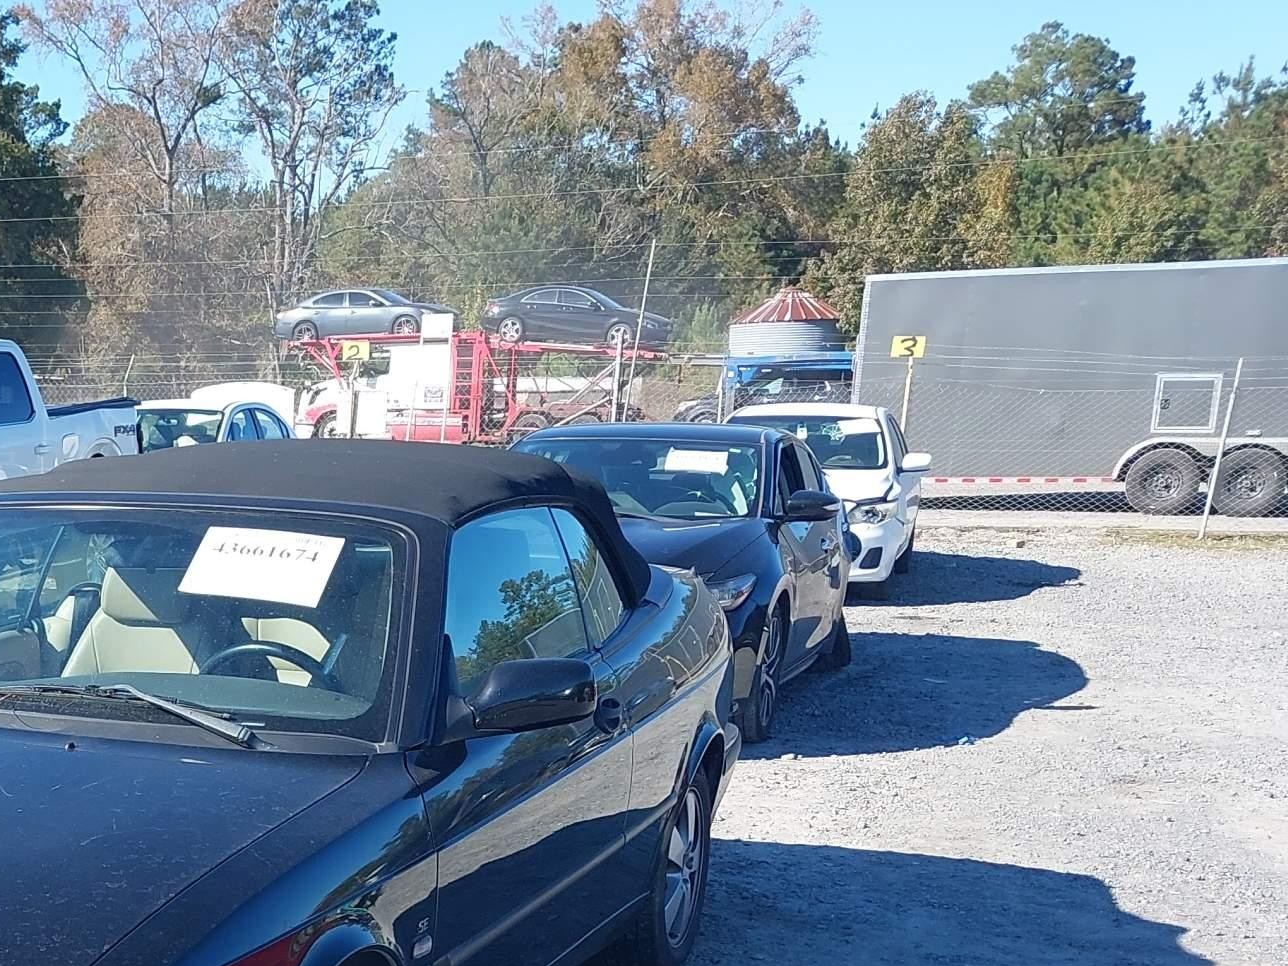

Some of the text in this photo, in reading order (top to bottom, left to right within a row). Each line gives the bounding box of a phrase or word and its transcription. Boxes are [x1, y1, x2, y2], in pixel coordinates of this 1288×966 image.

[345, 344, 363, 360] 2
[900, 336, 918, 357] 3
[114, 424, 136, 438] FX4
[417, 917, 430, 934] SE
